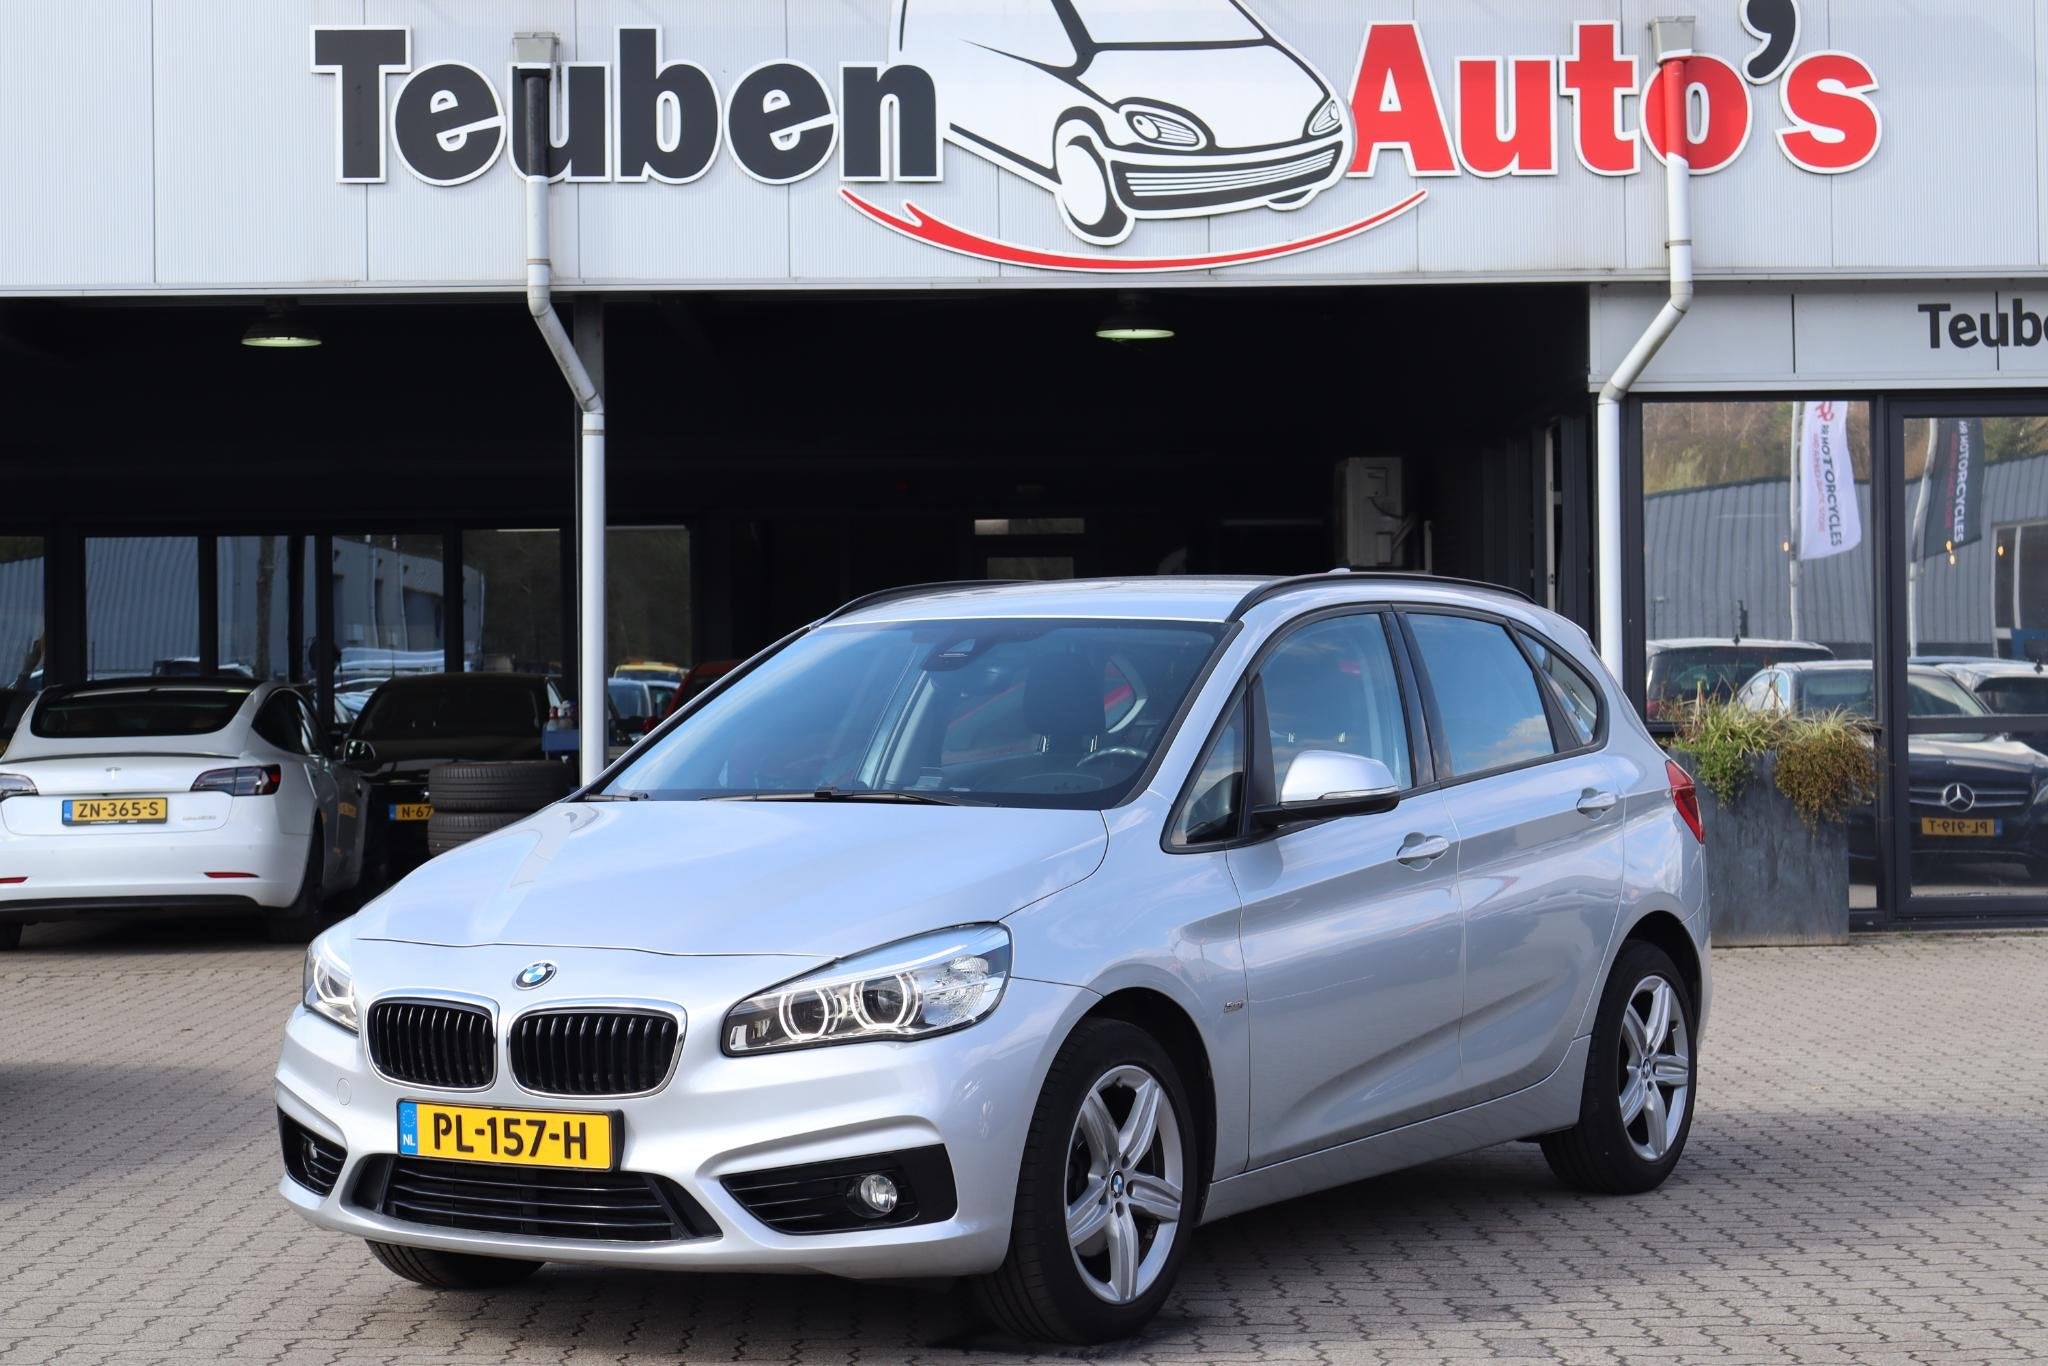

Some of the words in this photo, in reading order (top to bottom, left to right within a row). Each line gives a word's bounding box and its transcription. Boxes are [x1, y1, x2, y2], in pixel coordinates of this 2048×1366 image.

[313, 27, 940, 182] Teuben
[1347, 0, 1883, 177] Auto's
[1917, 298, 2048, 349] Teub
[1820, 436, 1842, 546] MOTORCYCLES
[1953, 435, 1970, 542] MOTORCYCLES
[78, 801, 159, 818] ZN-365-S
[402, 1133, 416, 1147] NL
[432, 1111, 588, 1161] PL-157-H
